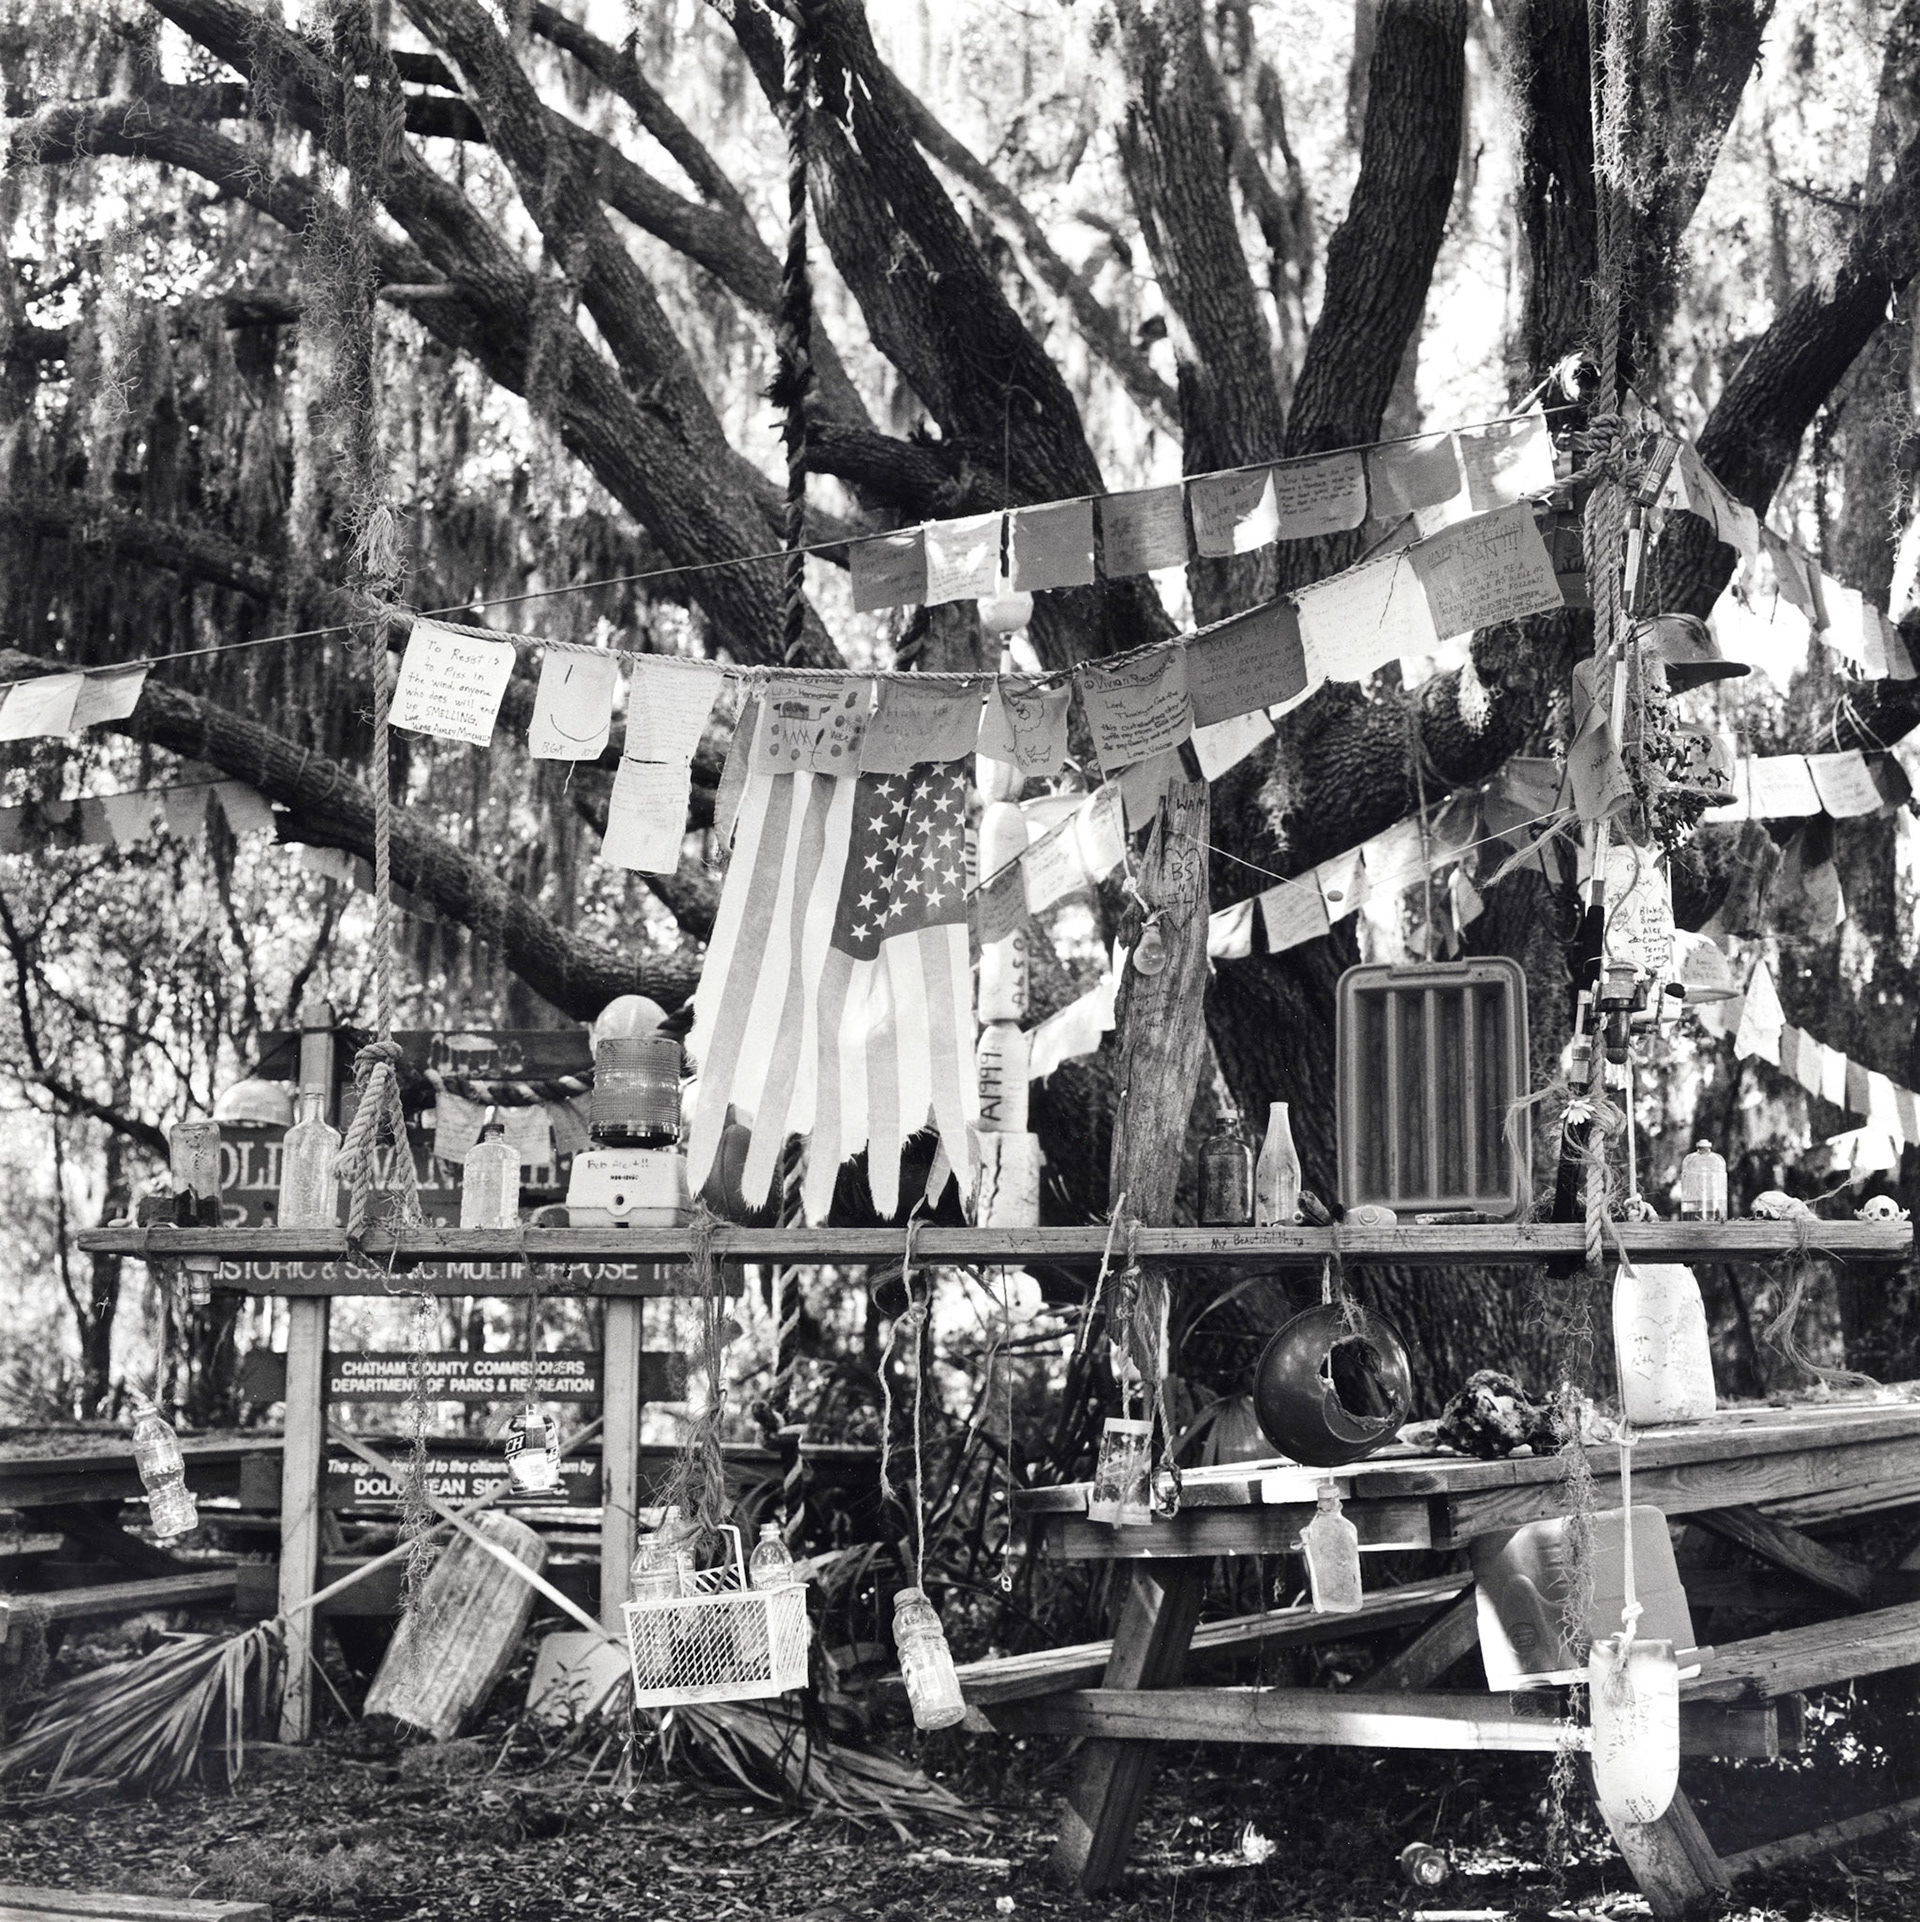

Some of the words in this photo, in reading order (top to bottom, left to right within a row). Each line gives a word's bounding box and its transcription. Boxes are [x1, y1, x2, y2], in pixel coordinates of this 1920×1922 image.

[428, 640, 441, 652] To
[451, 648, 484, 664] Resist
[425, 656, 434, 670] to
[444, 666, 465, 679] Piss
[408, 671, 424, 684] the
[1097, 674, 1130, 690] Vivian
[405, 687, 424, 698] who
[429, 690, 447, 703] does
[455, 699, 474, 709] will
[1101, 723, 1117, 732] this
[1172, 861, 1194, 881] BS
[979, 1052, 1003, 1121] A1999
[213, 1261, 315, 1280] ISTORIC
[341, 1361, 407, 1375] CHATHAM
[411, 1361, 469, 1375] COUNTY
[426, 1378, 445, 1392] OF
[450, 1378, 494, 1392] PARKS
[497, 1378, 507, 1392] &
[327, 1459, 349, 1473] The
[449, 1459, 468, 1474] the
[580, 1460, 597, 1476] by
[424, 1478, 466, 1496] EAN
